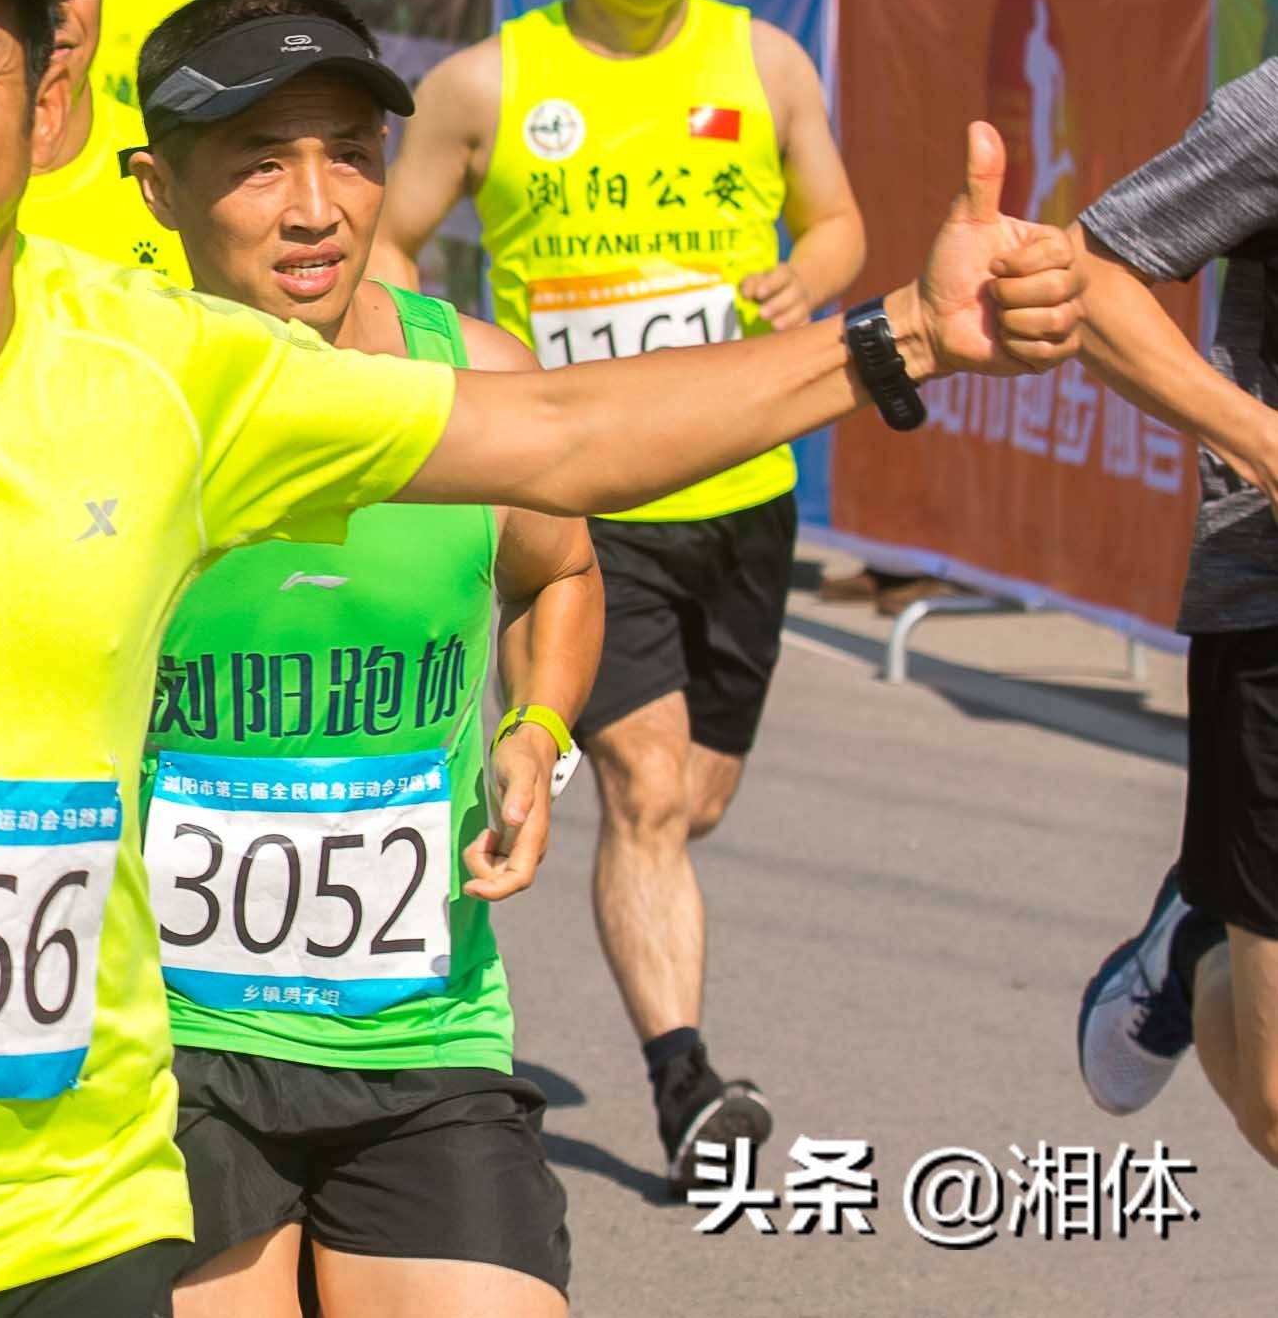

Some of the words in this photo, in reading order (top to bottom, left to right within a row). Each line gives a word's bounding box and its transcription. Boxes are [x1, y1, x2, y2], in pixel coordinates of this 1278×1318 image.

[526, 163, 747, 217] 浏阳公安
[147, 632, 465, 741] 浏阳跑协
[159, 823, 428, 958] 3052
